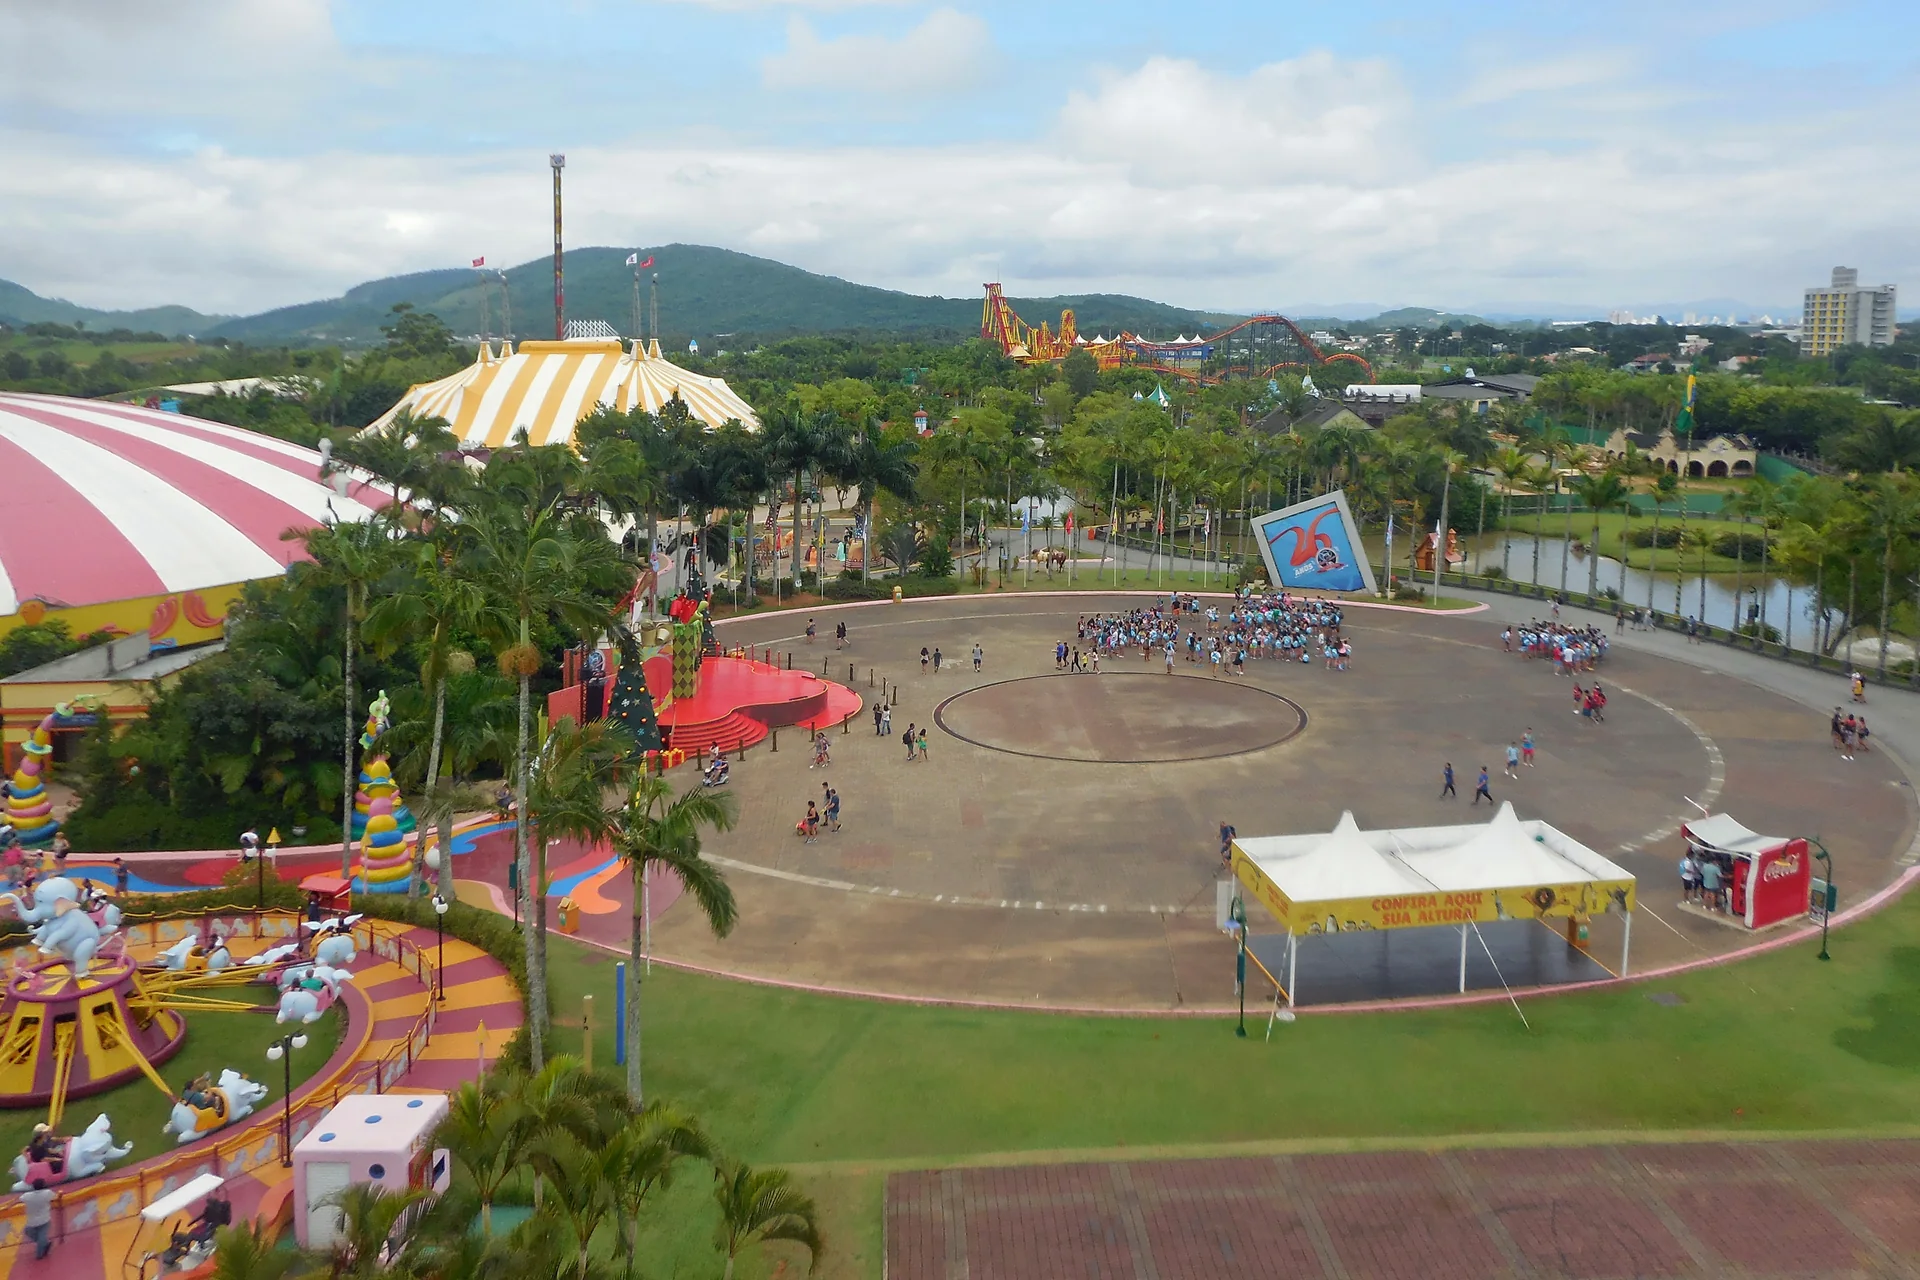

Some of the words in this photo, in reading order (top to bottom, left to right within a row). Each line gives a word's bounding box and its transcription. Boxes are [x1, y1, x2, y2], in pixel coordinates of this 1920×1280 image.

[1372, 895, 1437, 911] CONFIRA
[1444, 892, 1482, 908] AQUI
[1382, 911, 1411, 926] SUA
[1418, 908, 1477, 923] ALTURA!
